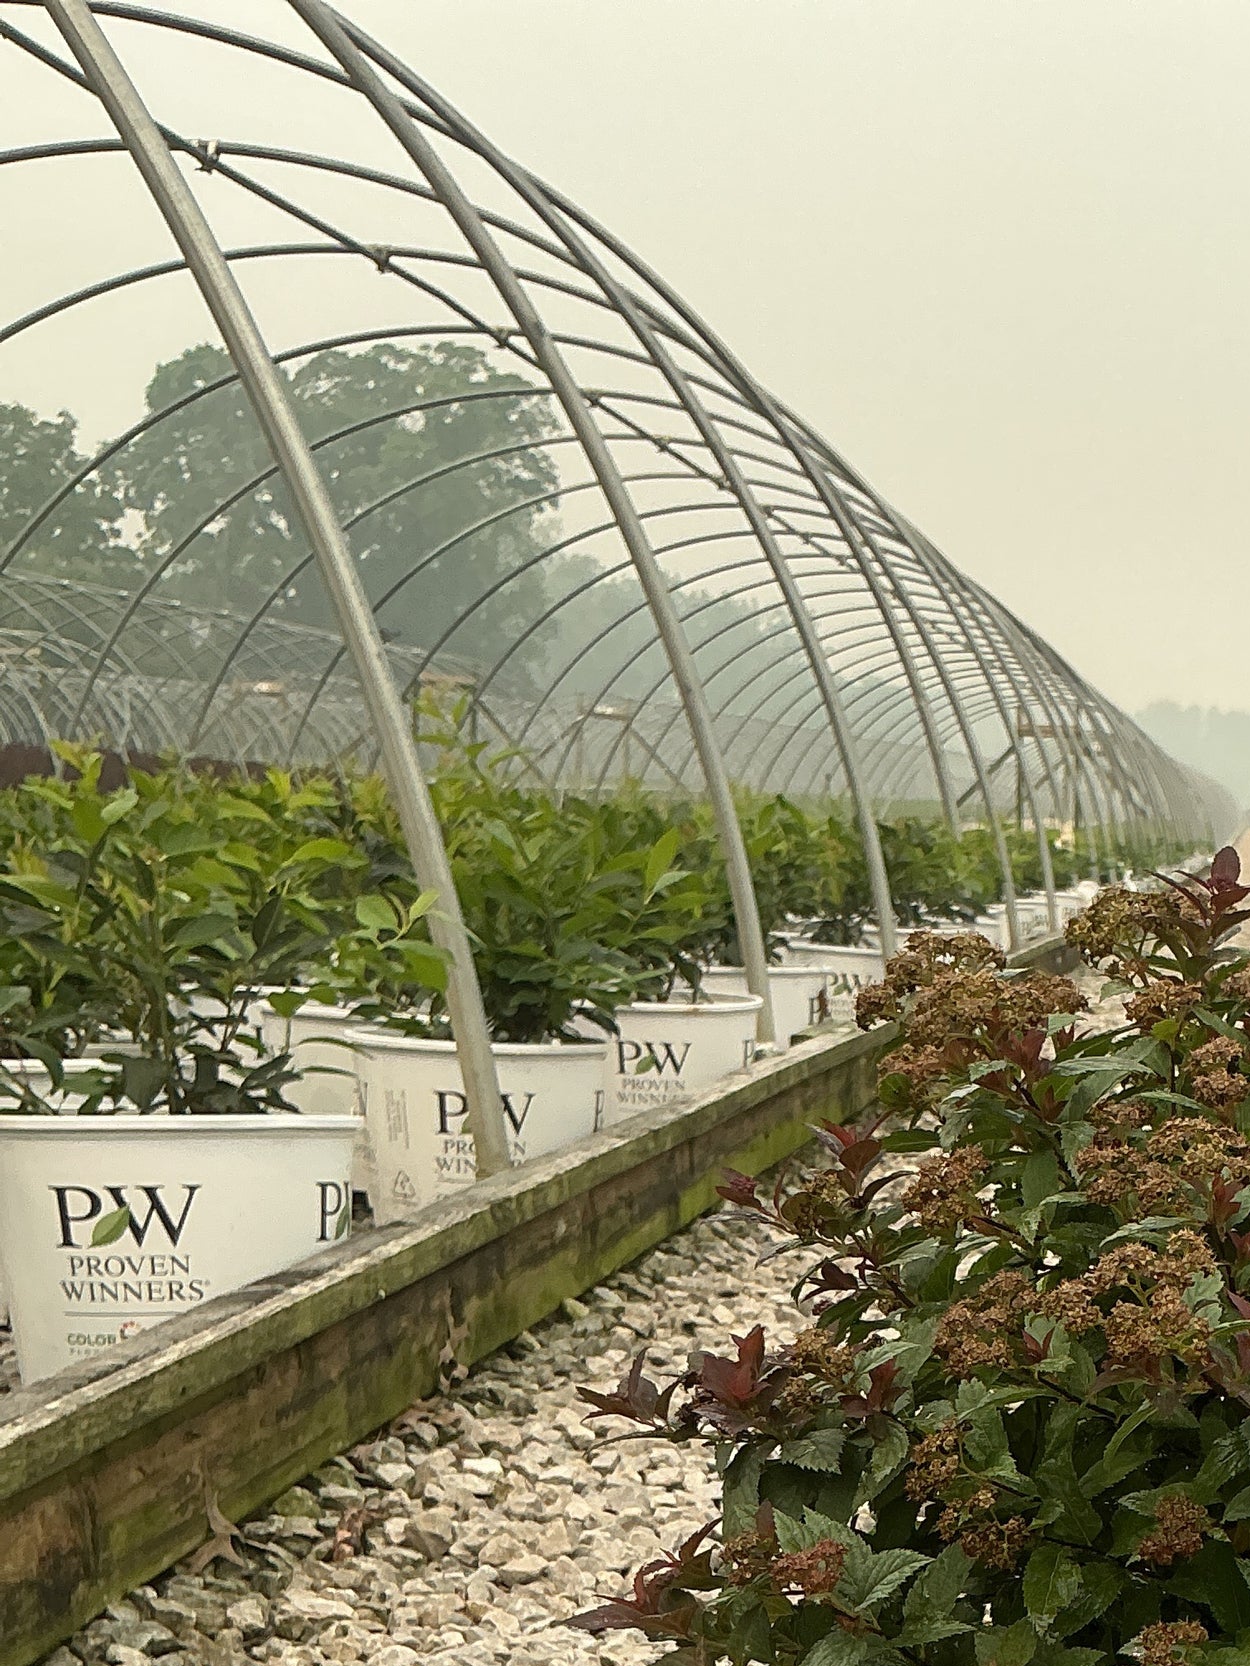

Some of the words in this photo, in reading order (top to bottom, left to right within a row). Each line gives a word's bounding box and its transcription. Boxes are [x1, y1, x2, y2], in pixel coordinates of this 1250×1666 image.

[616, 1039, 692, 1076] PW
[48, 1184, 202, 1248] PW
[69, 1254, 192, 1278] PROVEN
